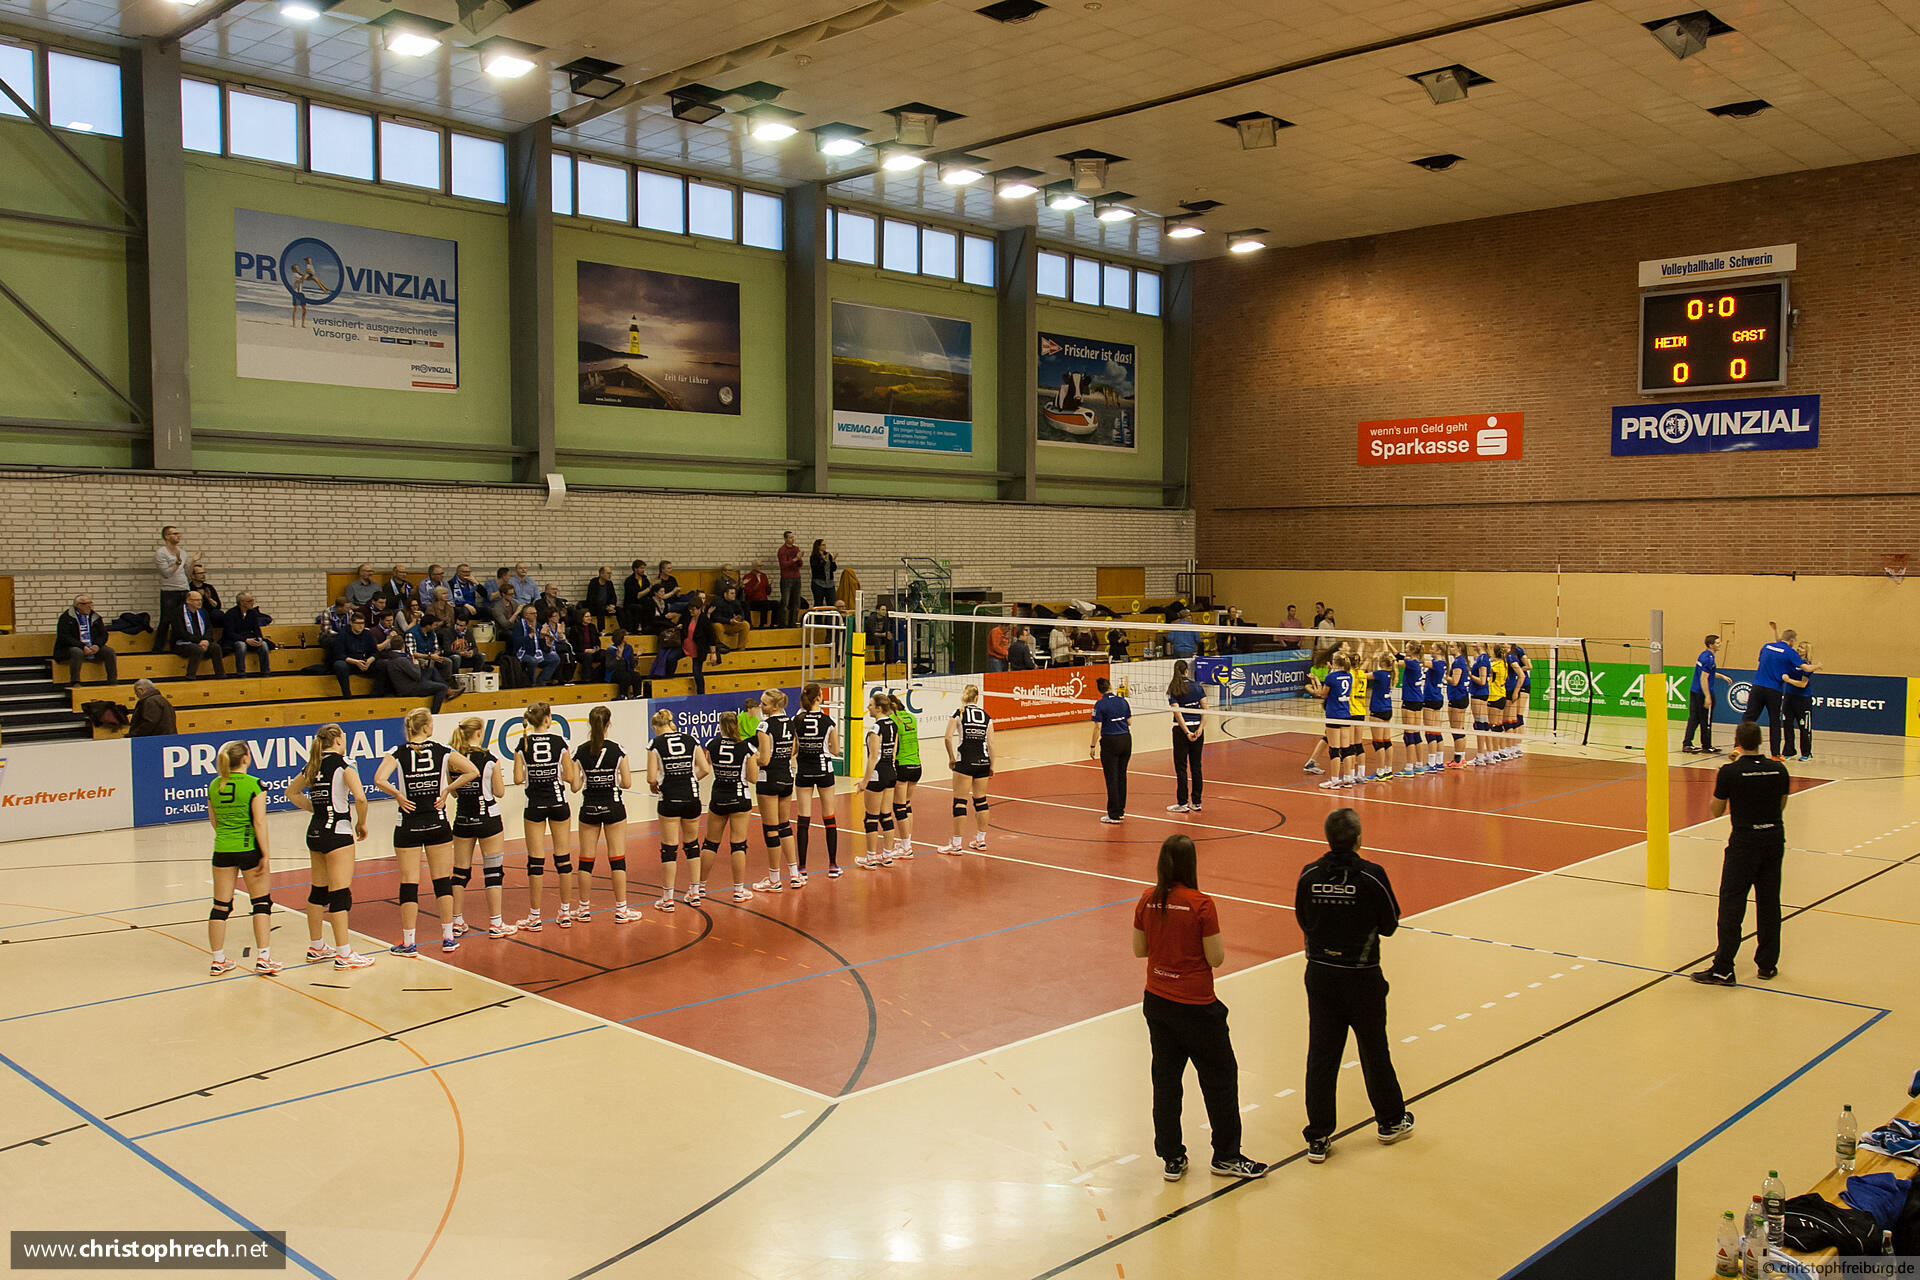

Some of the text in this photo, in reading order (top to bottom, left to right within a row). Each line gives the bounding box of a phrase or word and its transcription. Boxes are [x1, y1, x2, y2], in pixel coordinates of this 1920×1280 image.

[234, 238, 456, 305] PROVINZIAL
[1661, 252, 1773, 276] Volleyballhalle Schwerin
[1687, 296, 1735, 320] 0:0
[312, 317, 438, 337] versichert: ausgezeichnete
[313, 327, 360, 341] Vorsorge.
[1732, 328, 1767, 343] GAST
[1654, 335, 1687, 349] HEIM
[1064, 344, 1099, 359] Frischer
[1101, 348, 1112, 361] ist
[1114, 350, 1132, 364] das!
[411, 364, 453, 374] PROVINZIAL
[664, 373, 676, 382] Zeit
[1672, 362, 1689, 383] 0
[1729, 358, 1747, 380] 0
[837, 422, 871, 433] WEMAG
[871, 426, 885, 435] AG
[1370, 422, 1468, 436] wenn's um Geld geht
[1621, 408, 1810, 444] PROVINZIAL
[1370, 438, 1470, 460] Sparkasse
[1251, 670, 1304, 686] Nord Stream
[1341, 679, 1350, 695] 9
[1545, 669, 1606, 696] AOK
[1622, 673, 1688, 702] AK
[1012, 682, 1075, 701] Studienkreis
[1826, 697, 1886, 711] RESPECT
[966, 707, 986, 724] 10
[782, 722, 793, 740] 4
[803, 718, 819, 737] 3
[163, 729, 391, 778] PRVINAL
[532, 742, 552, 763] 8
[666, 737, 686, 756] 6
[718, 745, 735, 764] 5
[410, 749, 435, 772] 13
[1, 785, 116, 808] Kraftverkehr
[164, 783, 209, 801] Henni
[165, 803, 209, 816] Dr.-Külz-
